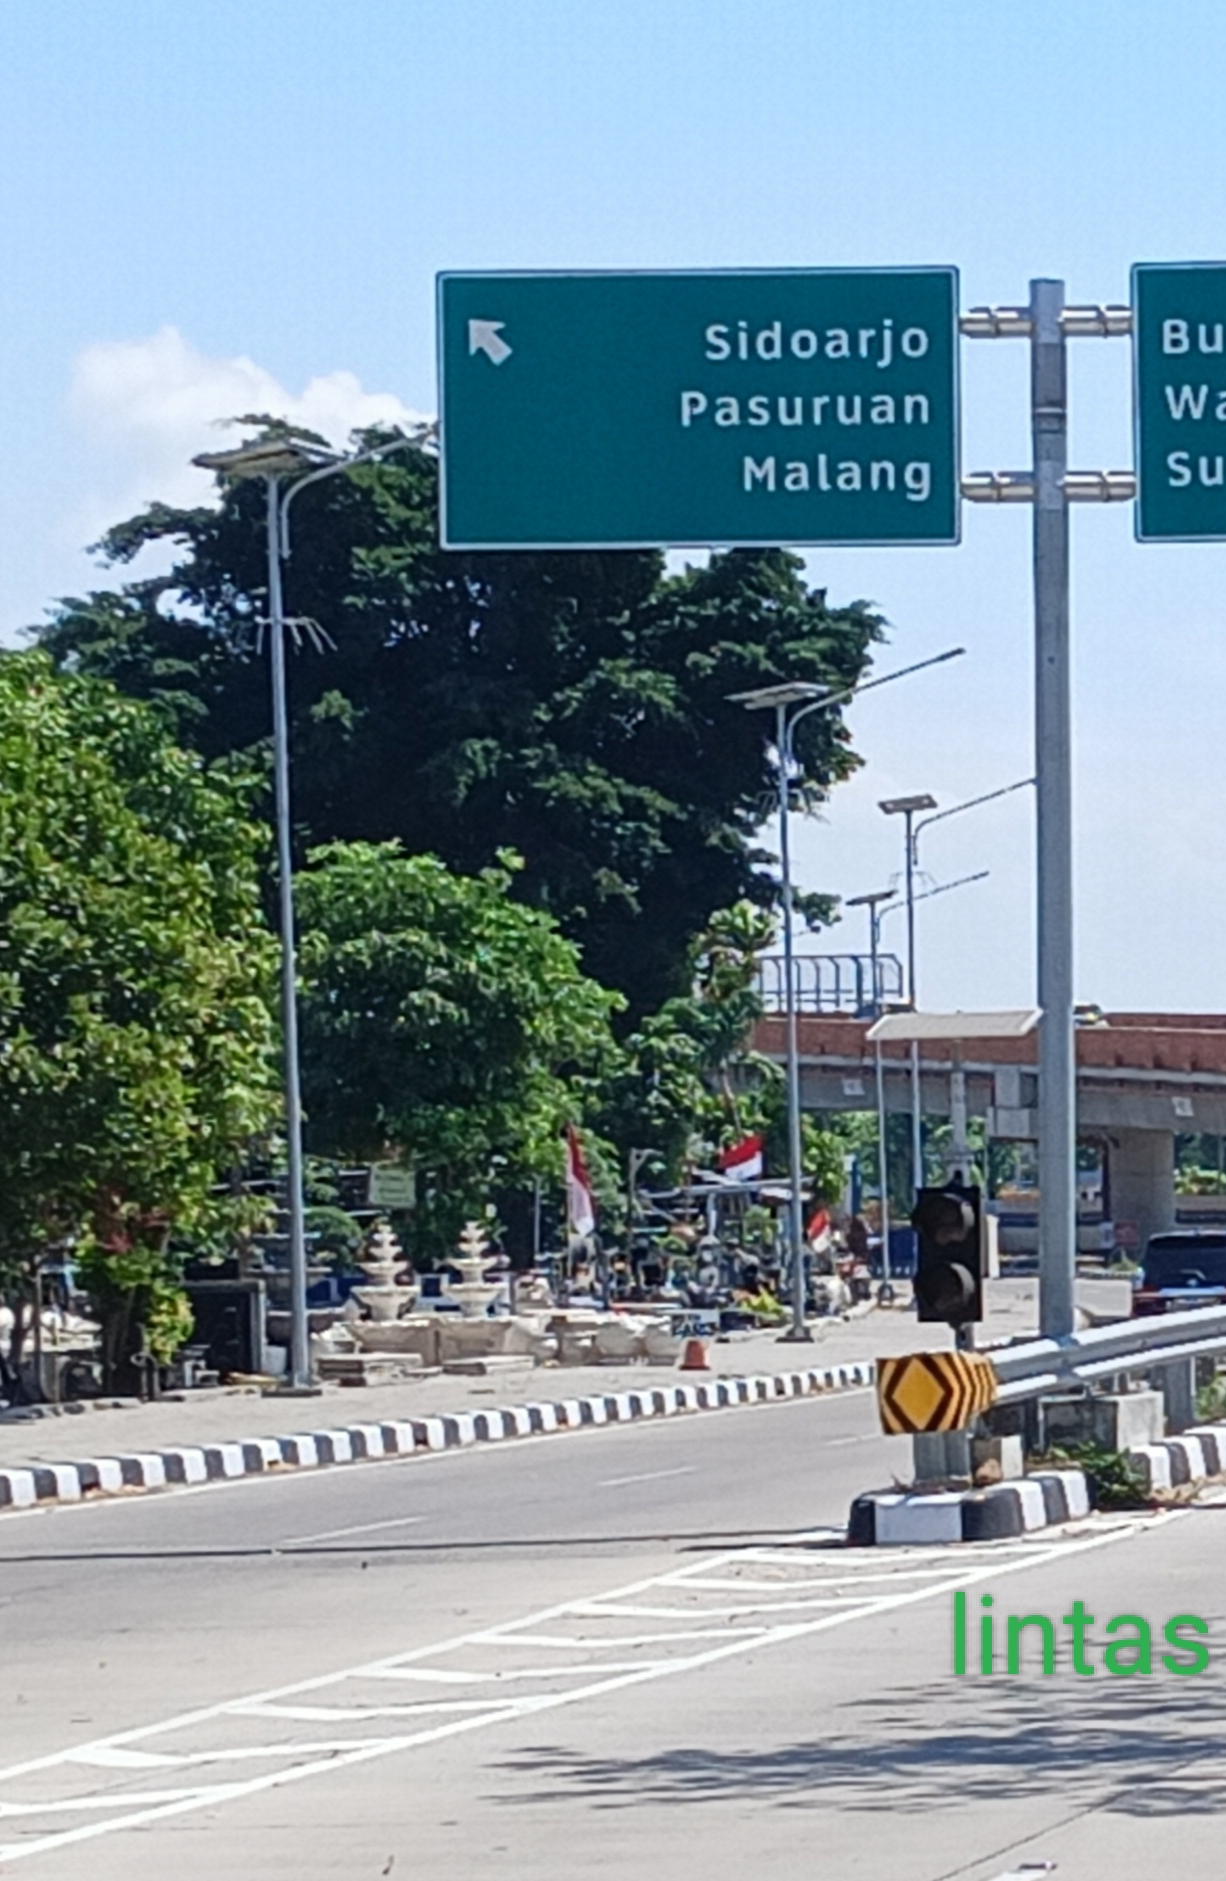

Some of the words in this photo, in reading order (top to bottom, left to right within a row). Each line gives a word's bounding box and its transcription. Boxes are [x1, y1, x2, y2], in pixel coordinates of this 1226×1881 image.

[704, 318, 930, 368] Sidoarjo
[681, 391, 929, 427] Pasuruan
[743, 455, 932, 502] Malang
